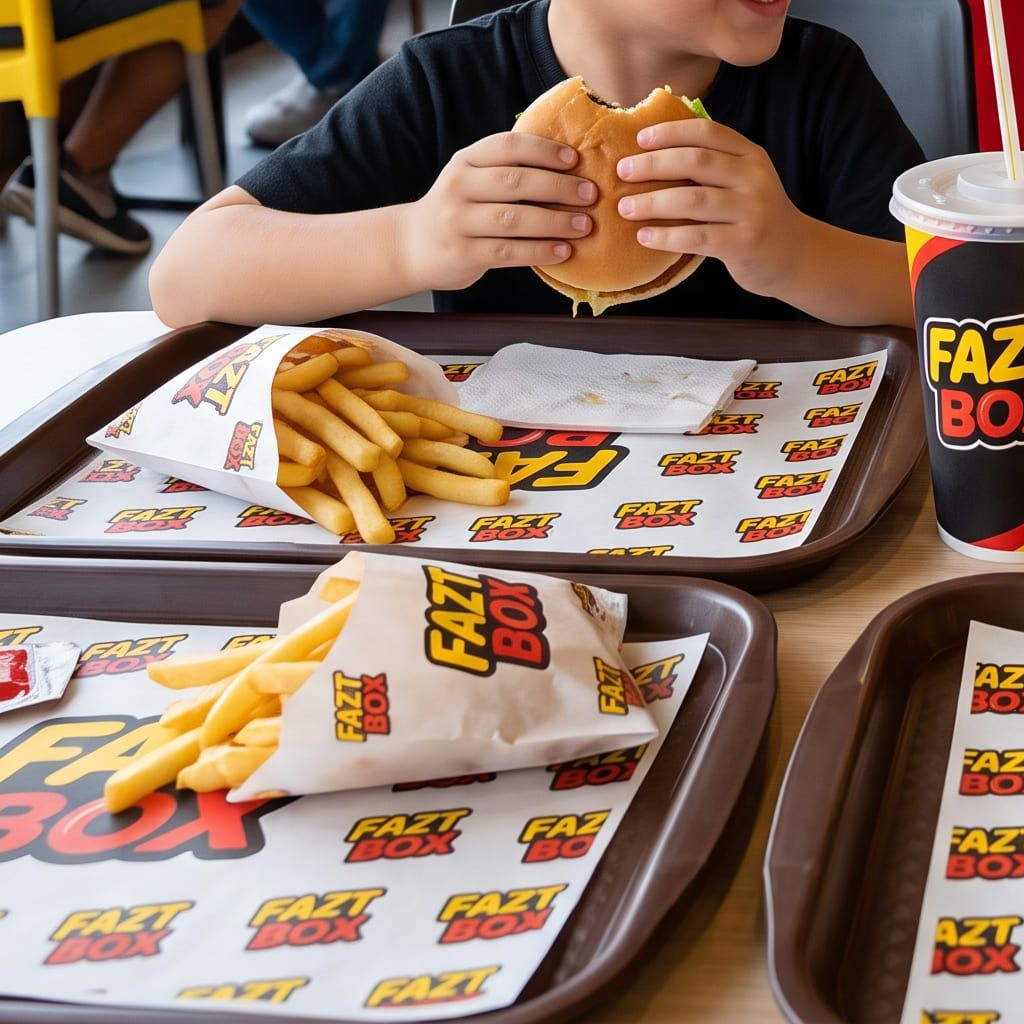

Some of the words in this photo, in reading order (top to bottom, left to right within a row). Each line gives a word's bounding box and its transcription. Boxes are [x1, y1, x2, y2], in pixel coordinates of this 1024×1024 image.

[224, 422, 249, 471] BOX
[659, 450, 741, 467] FAZT
[662, 462, 736, 476] BOX
[110, 507, 205, 523] FAZT
[471, 513, 560, 531] FAZT
[615, 500, 701, 518] FAZT
[618, 513, 696, 529] BOX
[473, 526, 553, 542] BOX
[428, 566, 490, 672] FAZT
[487, 576, 544, 665] BOX
[82, 635, 187, 661] FAZT
[334, 672, 366, 742] FAZT
[362, 674, 390, 735] BOX
[346, 808, 472, 842] FAZT
[345, 832, 460, 862] BOX
[251, 888, 386, 926] FAZT
[439, 884, 568, 921] FAZT
[51, 901, 195, 940] FAZT
[247, 915, 371, 950] BOX
[440, 908, 554, 943] BOX
[44, 928, 173, 964] BOX
[364, 967, 501, 1007] FAZT
